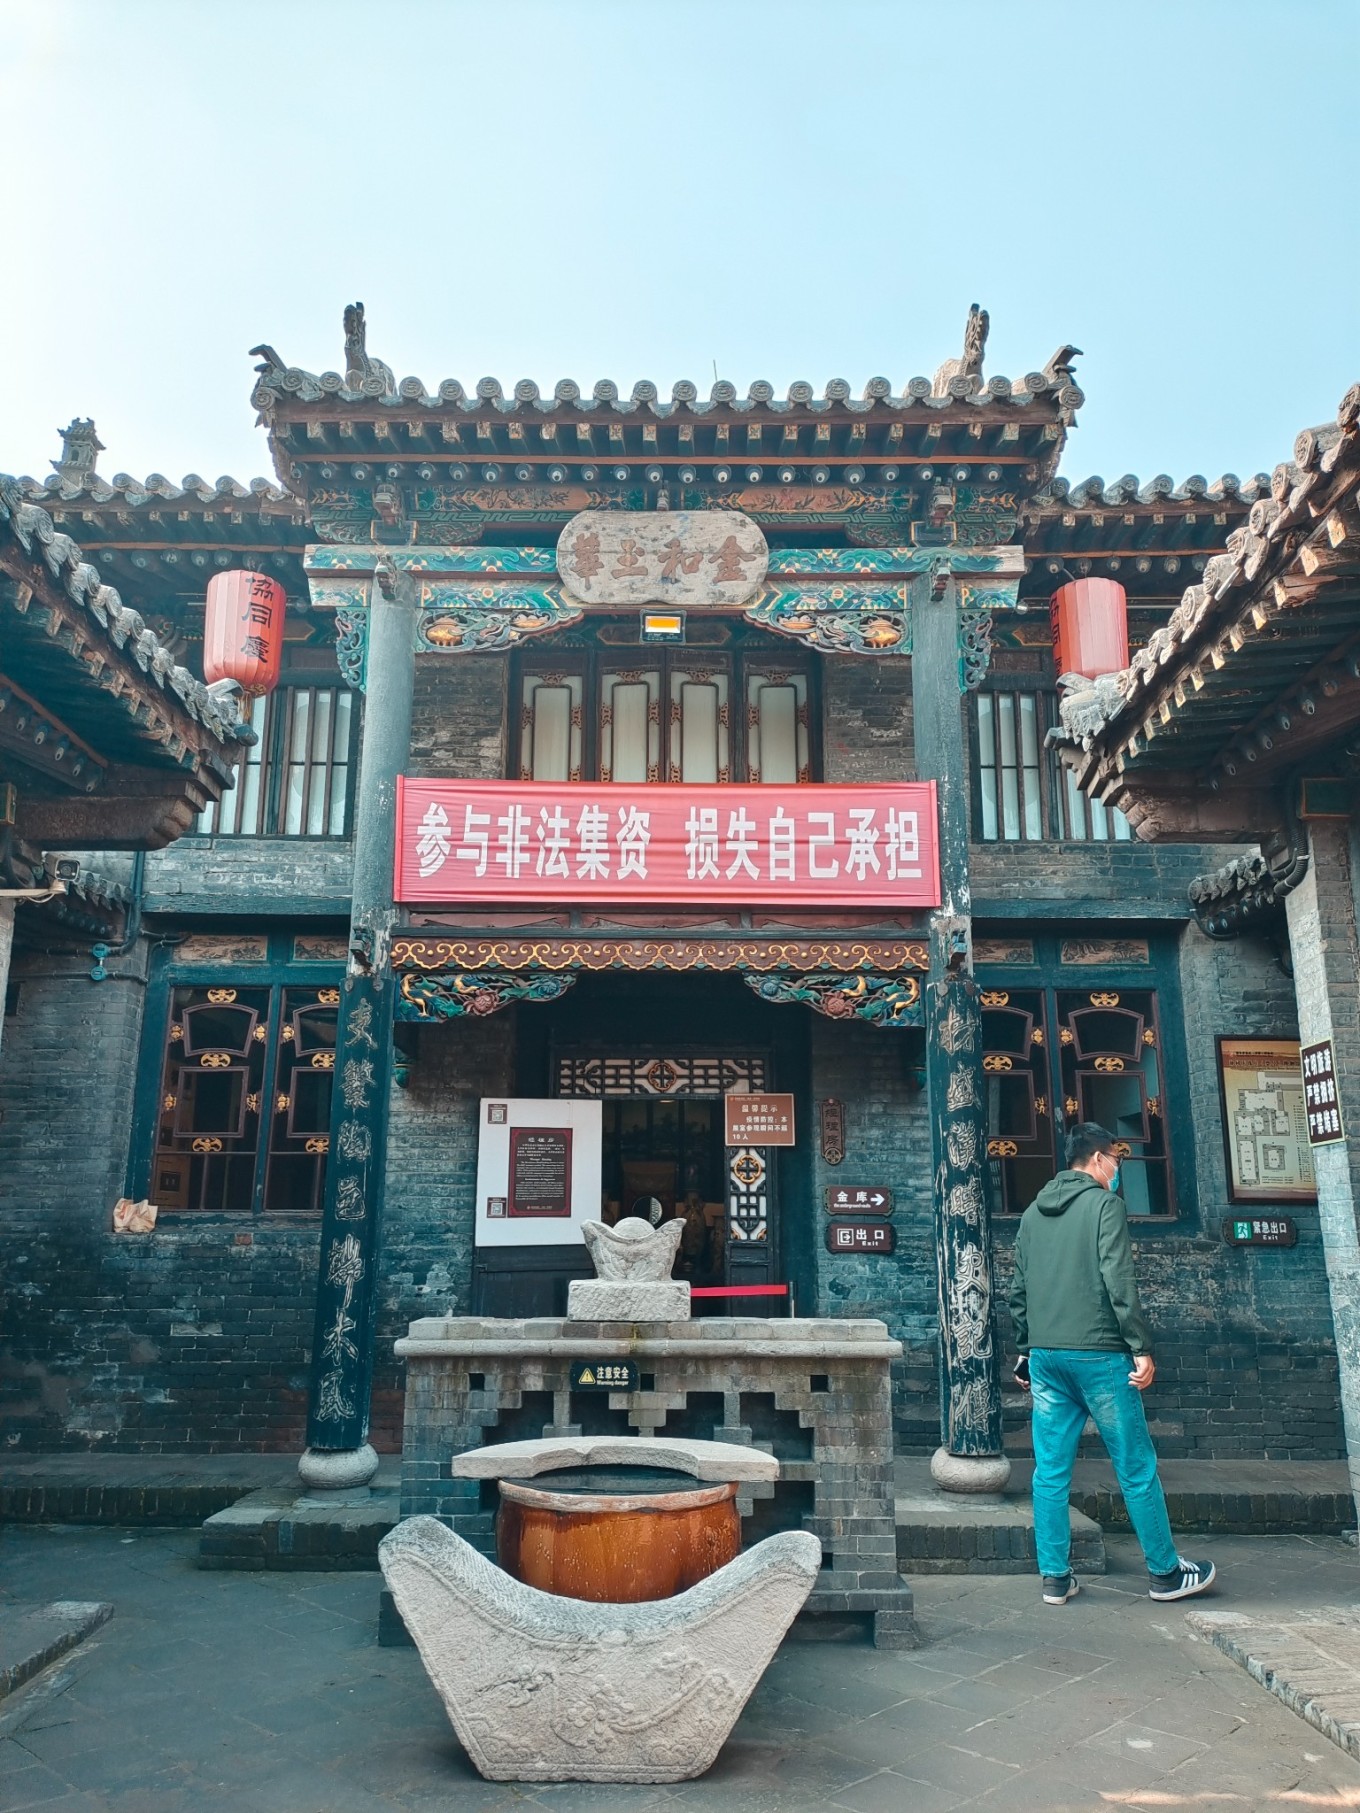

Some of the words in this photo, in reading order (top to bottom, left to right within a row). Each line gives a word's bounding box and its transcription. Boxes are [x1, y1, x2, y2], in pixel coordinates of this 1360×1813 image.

[415, 801, 653, 880] 参与非法集资
[685, 805, 923, 881] 损失自己承担
[741, 1104, 778, 1113] 温馨提示
[836, 1190, 868, 1203] 金库
[856, 1228, 885, 1240] 出口
[596, 1366, 629, 1379] 注意安全
